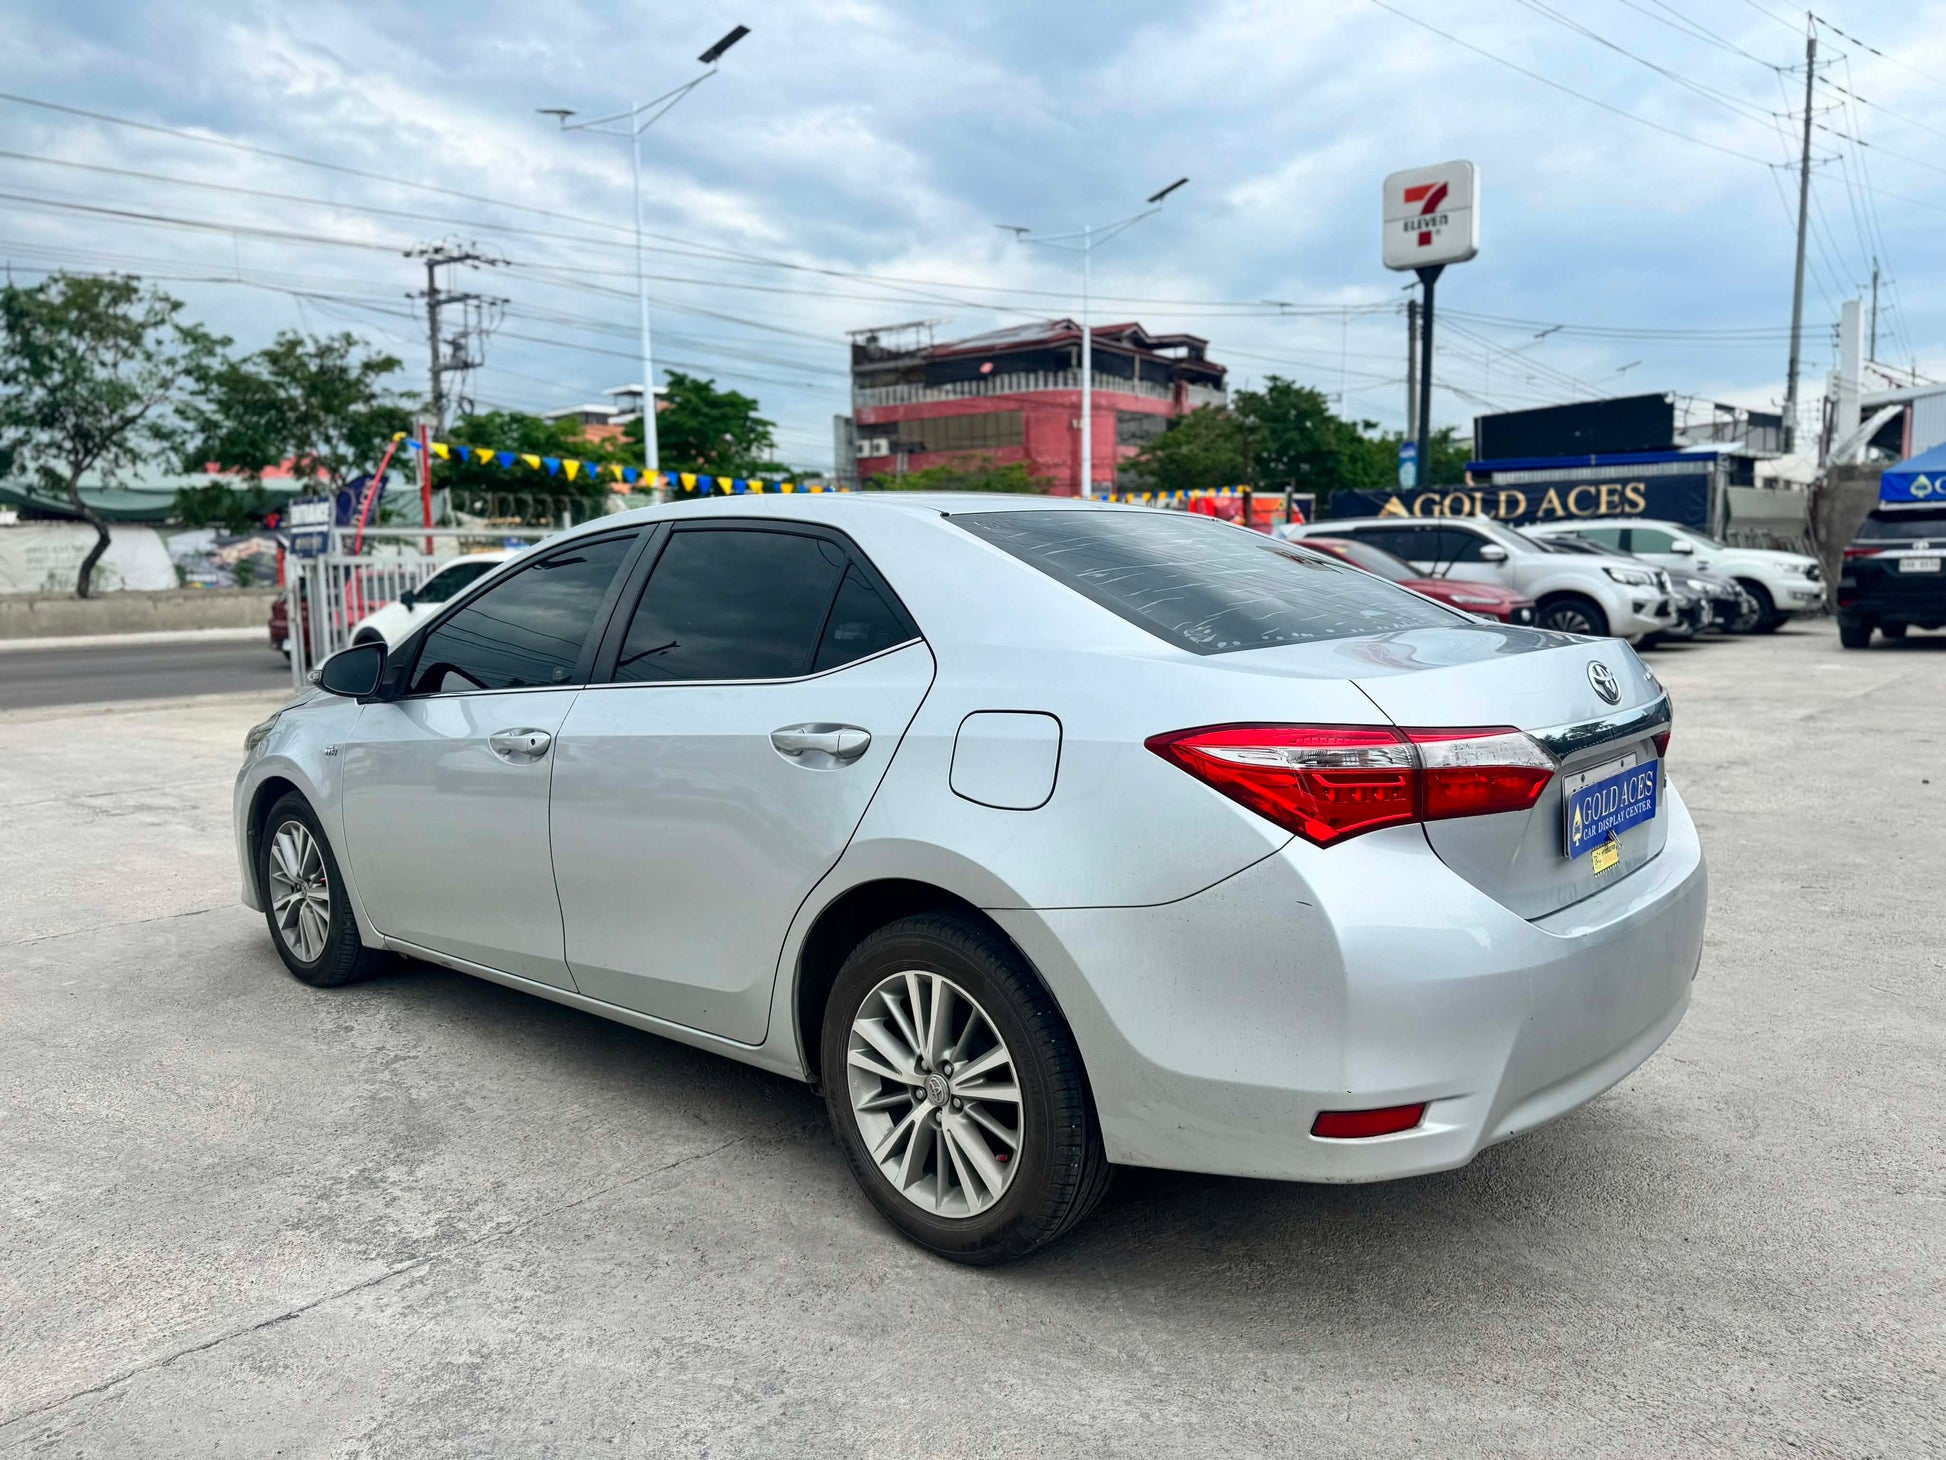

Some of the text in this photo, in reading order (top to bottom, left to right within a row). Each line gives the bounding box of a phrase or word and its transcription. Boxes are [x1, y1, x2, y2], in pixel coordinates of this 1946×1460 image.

[1403, 181, 1449, 247] 7
[1412, 482, 1646, 519] GOLD ACES
[1583, 771, 1654, 825] GOLD ACES
[1583, 799, 1652, 841] CAR DISPLAY CENTER
